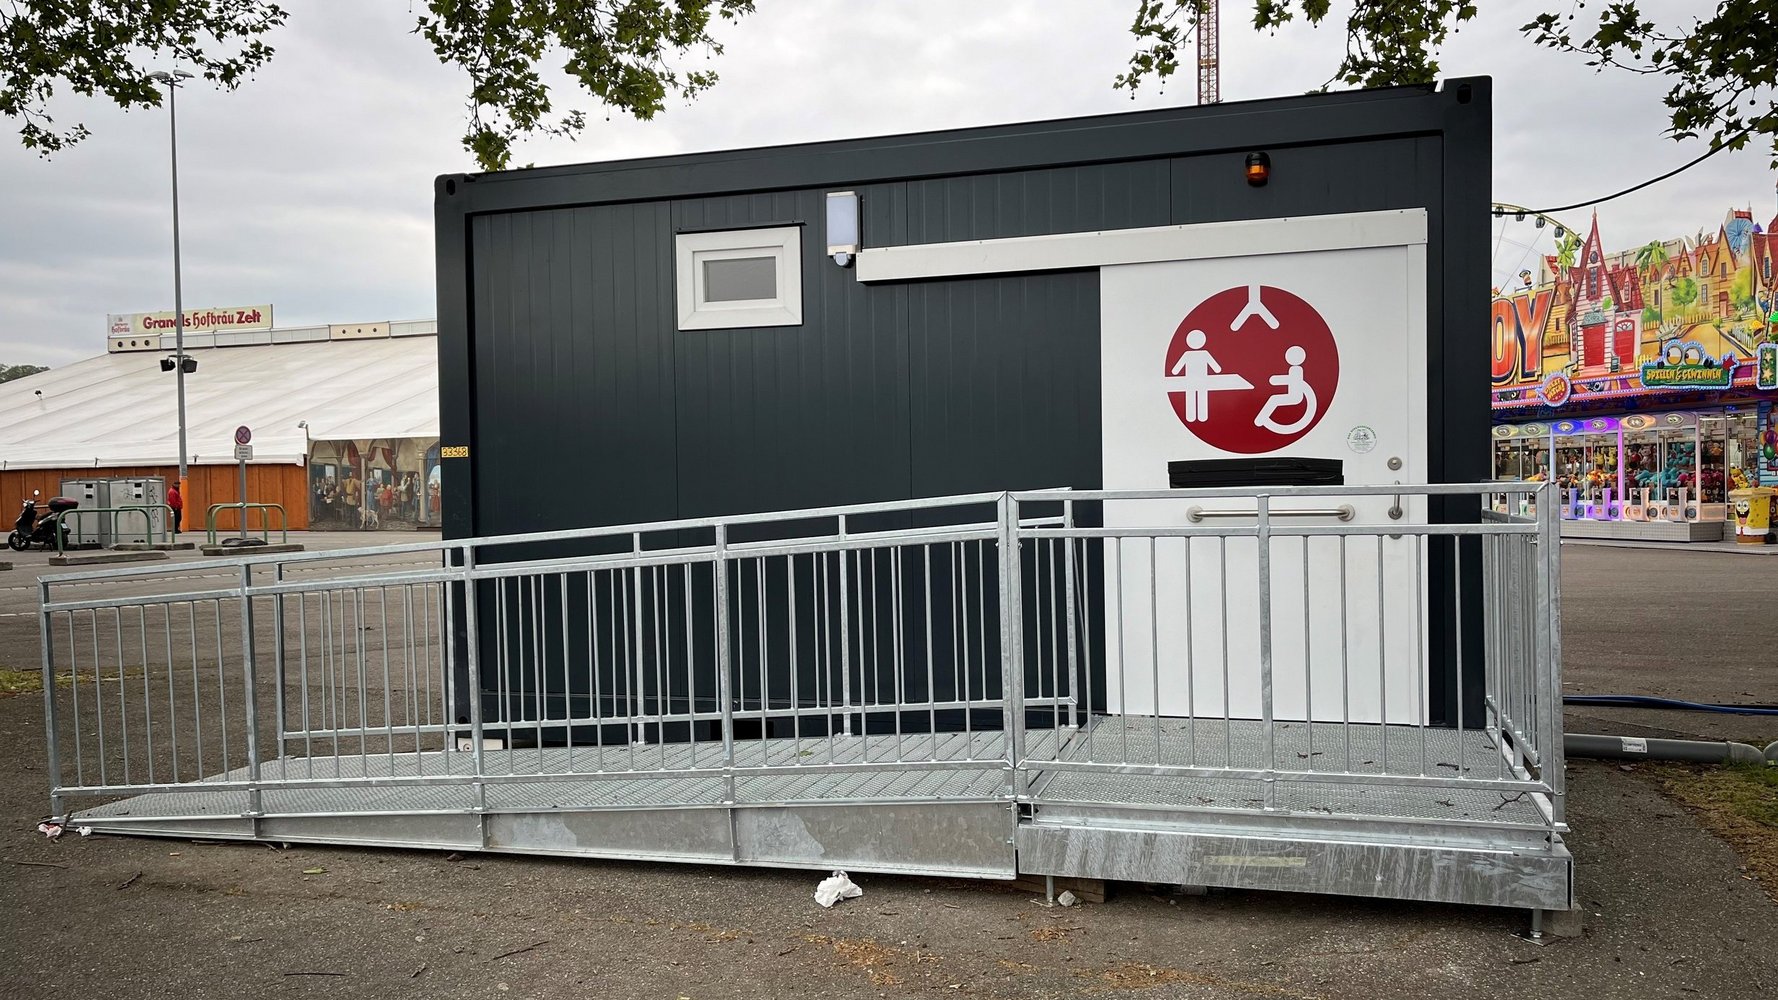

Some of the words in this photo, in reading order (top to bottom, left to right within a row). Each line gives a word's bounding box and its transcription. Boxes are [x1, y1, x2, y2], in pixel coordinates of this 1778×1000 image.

[192, 311, 234, 329] Hofbräu
[236, 309, 261, 324] Zelt
[1646, 368, 1675, 380] SPIELEN
[1682, 368, 1723, 380] GEWINNEN
